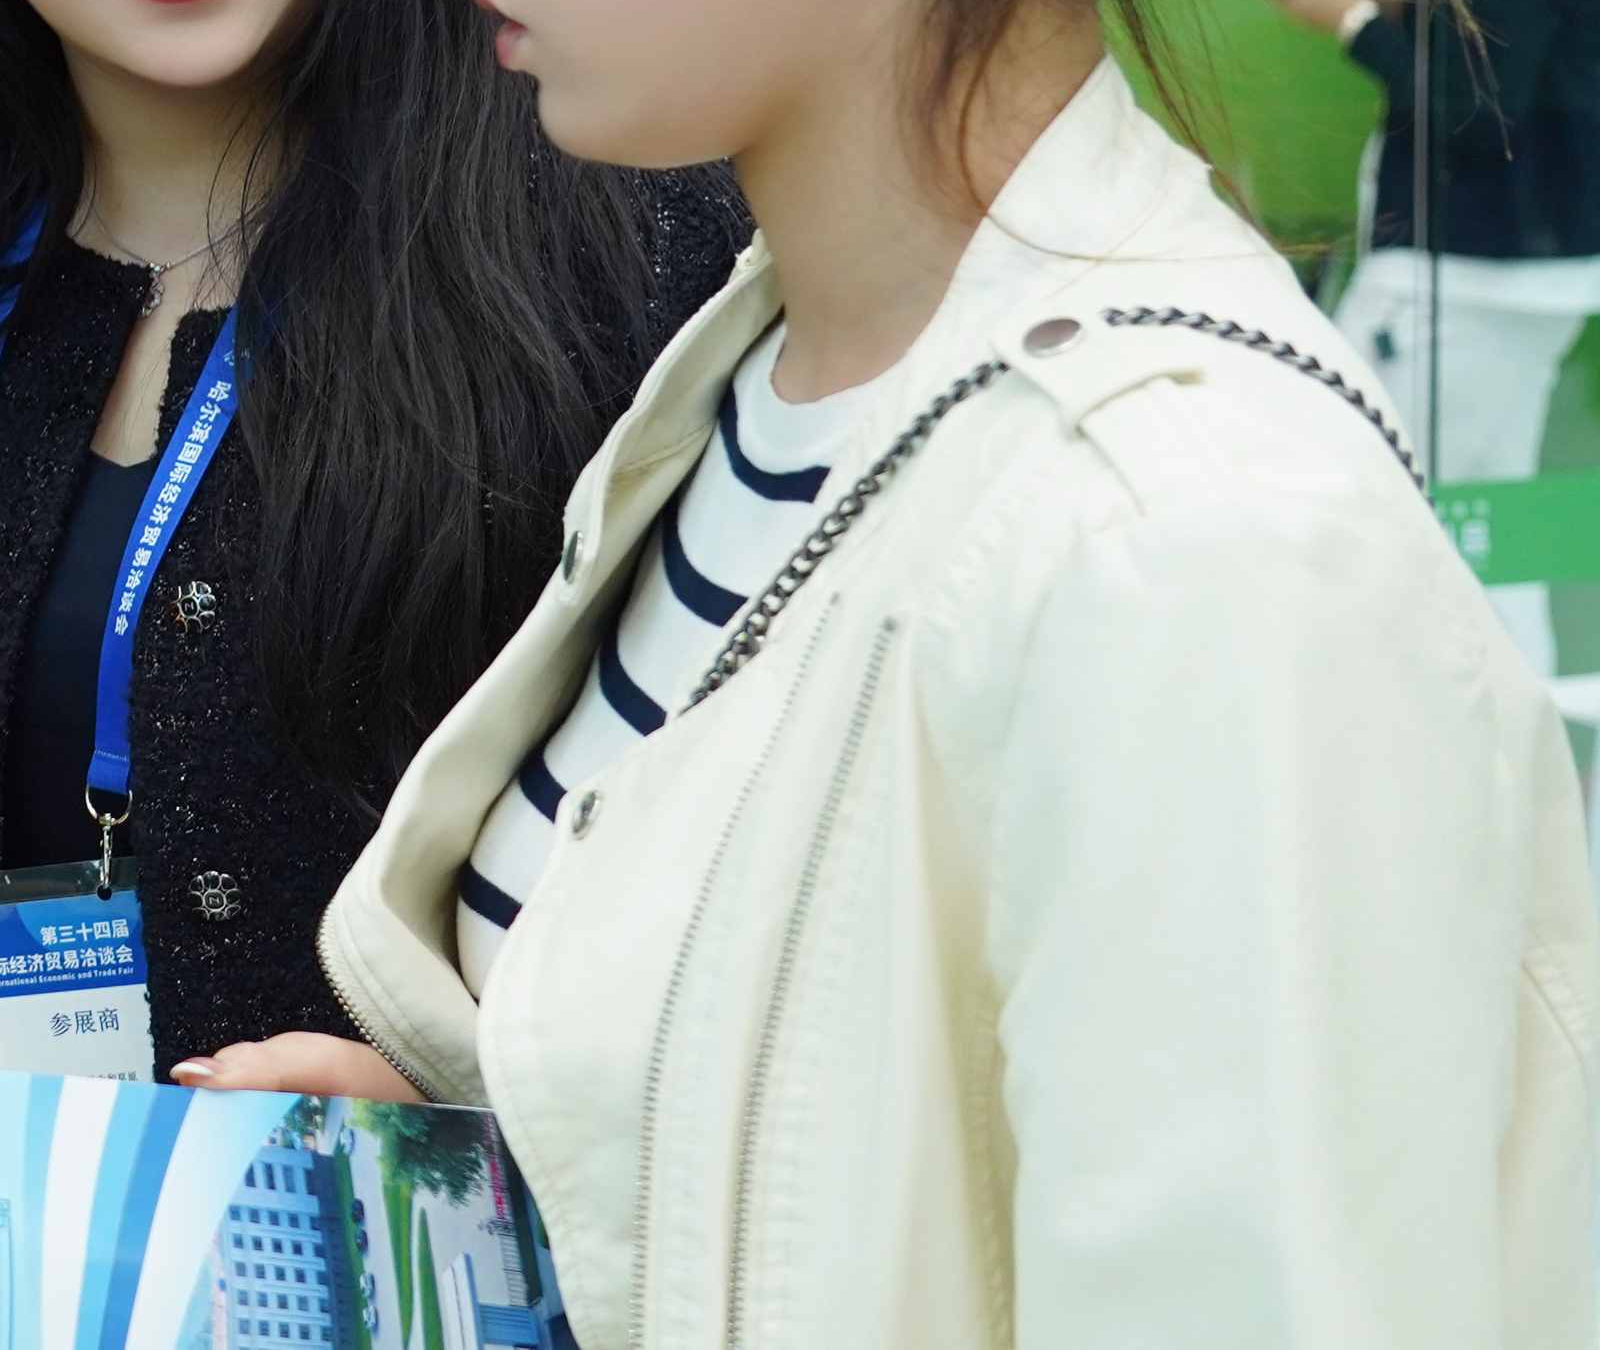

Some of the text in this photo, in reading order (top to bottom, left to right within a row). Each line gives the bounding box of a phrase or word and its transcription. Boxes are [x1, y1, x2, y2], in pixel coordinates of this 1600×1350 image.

[114, 381, 232, 636] 哈尔滨国际经济贸易洽谈会
[40, 919, 130, 947] 第三十四届
[39, 972, 76, 985] Economic
[51, 1008, 119, 1037] 参展商
